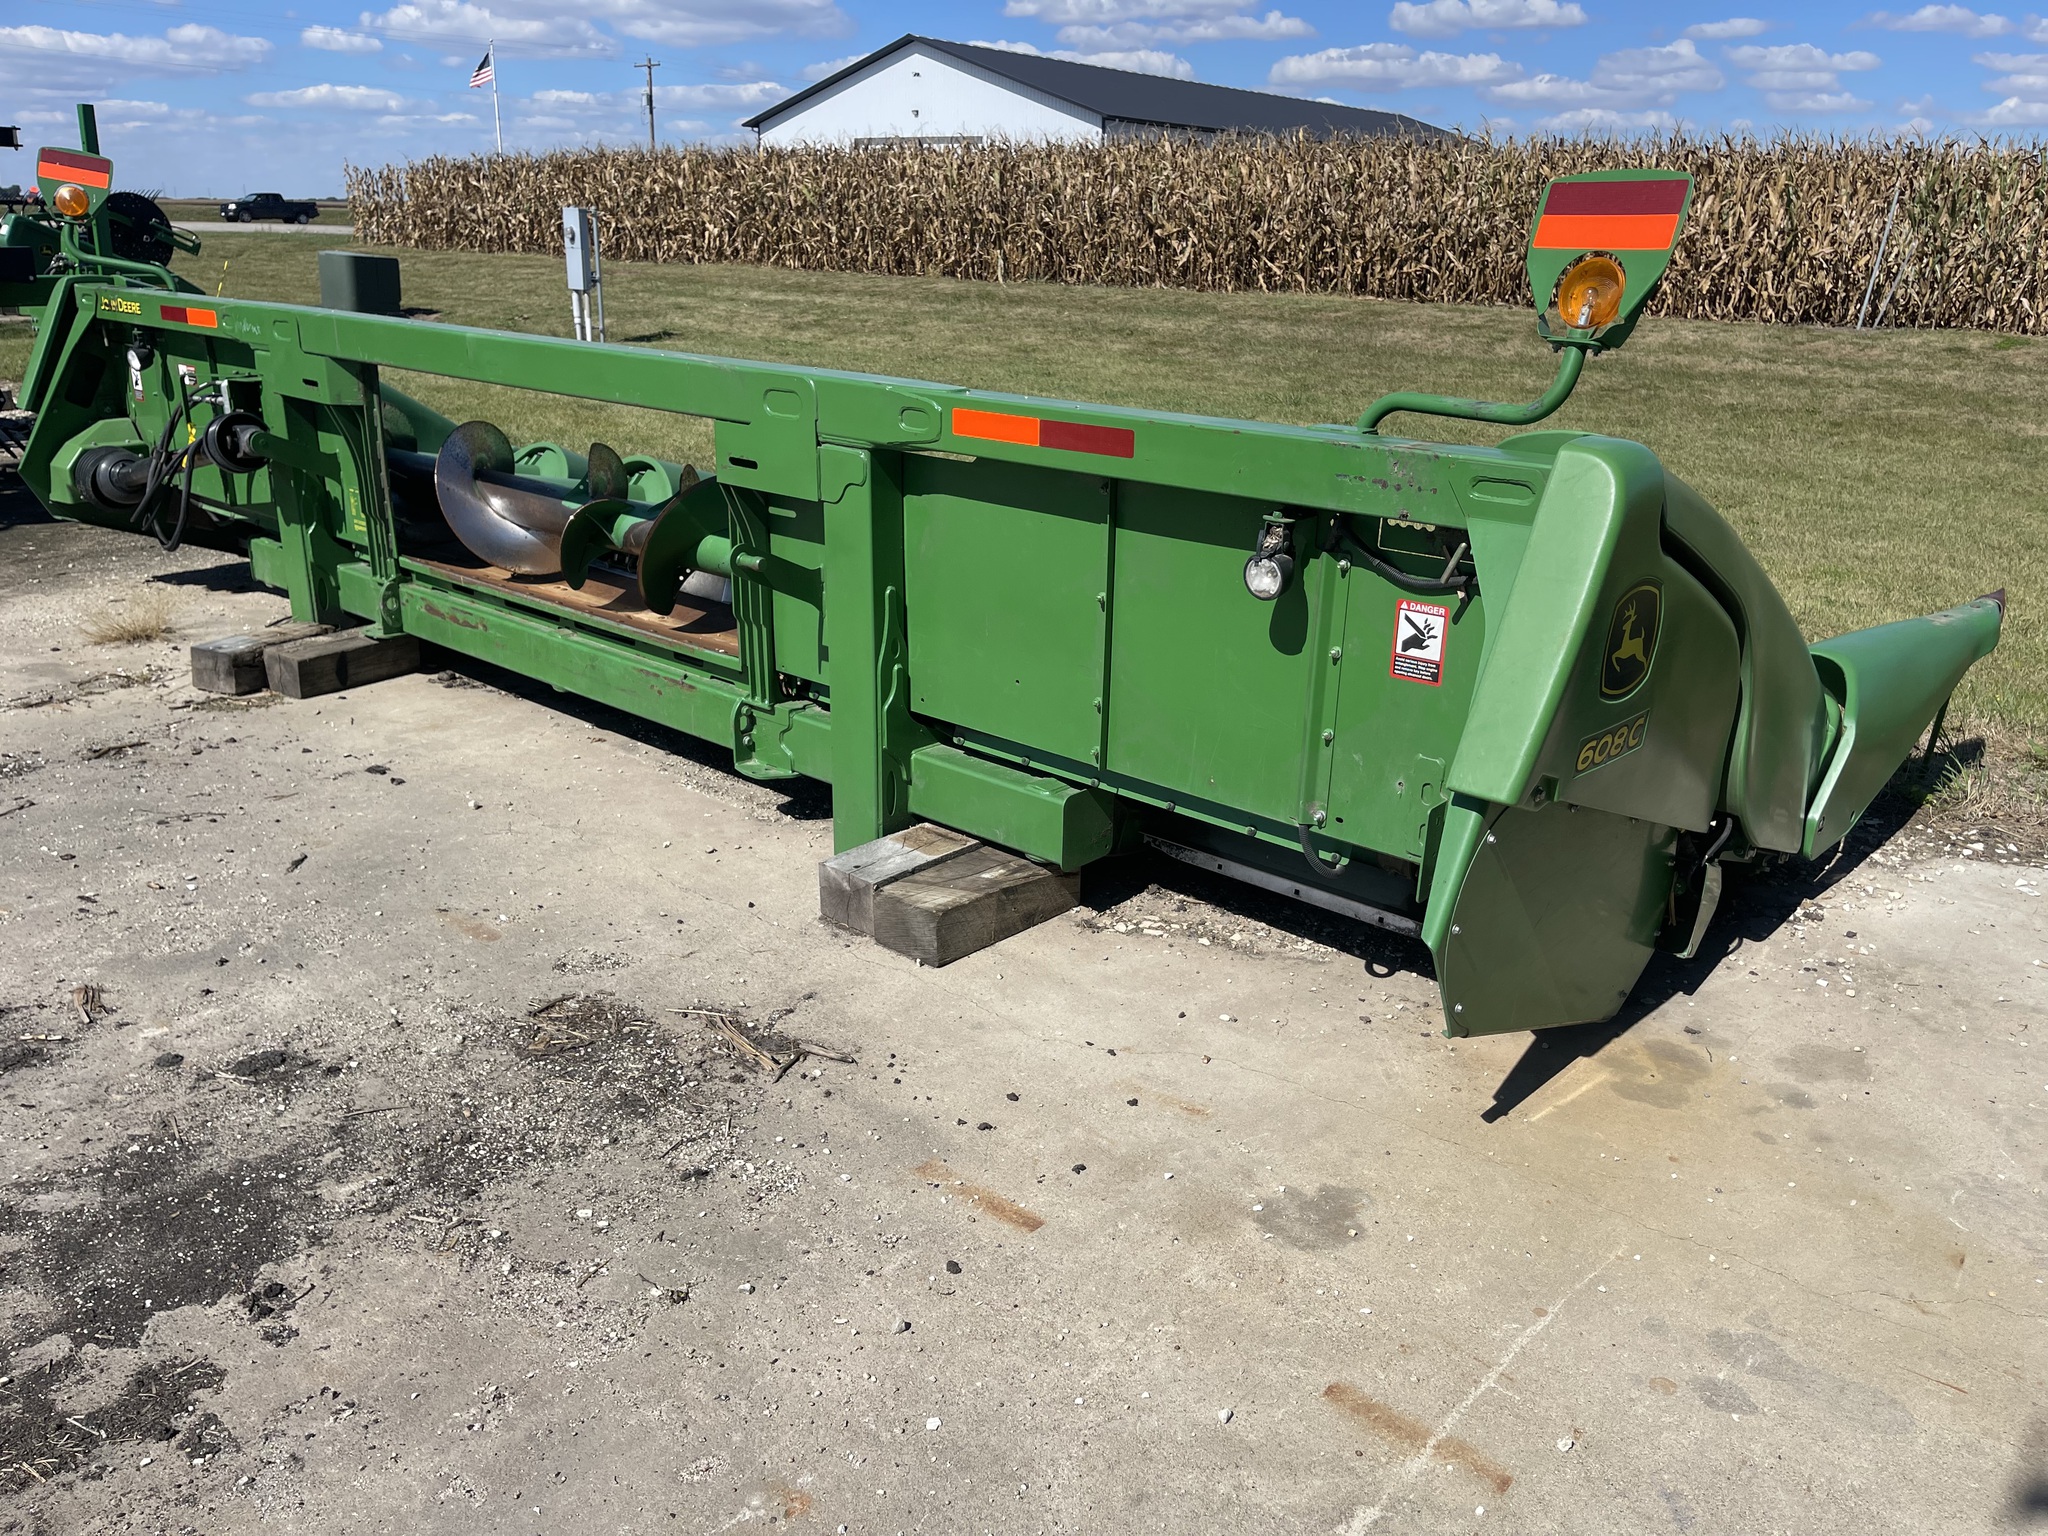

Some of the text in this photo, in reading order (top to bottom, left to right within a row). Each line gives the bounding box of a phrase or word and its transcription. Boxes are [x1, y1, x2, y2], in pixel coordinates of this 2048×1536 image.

[117, 298, 142, 315] DEERE
[1410, 602, 1446, 616] DANGER
[1576, 716, 1645, 771] 608C
